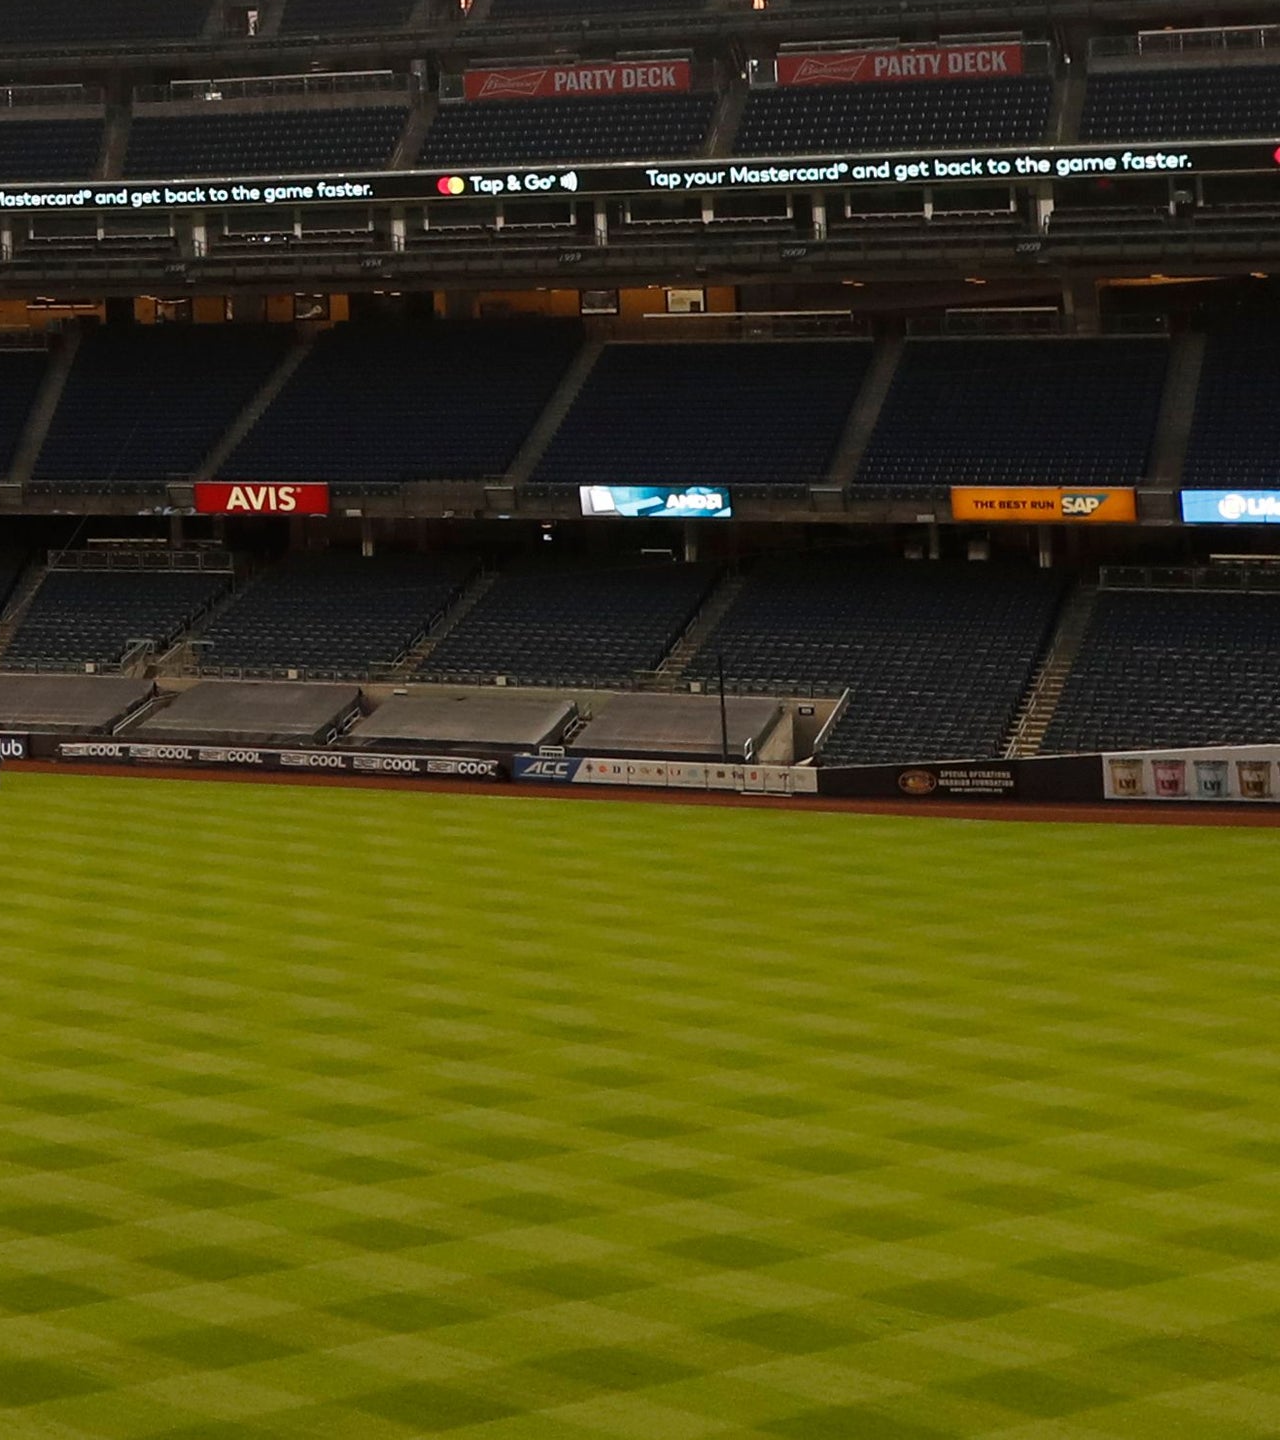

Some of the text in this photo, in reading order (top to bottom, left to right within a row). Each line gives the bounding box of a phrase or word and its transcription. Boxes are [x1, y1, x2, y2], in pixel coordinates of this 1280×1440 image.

[874, 50, 1007, 77] PARTY DECK
[554, 66, 676, 91] PARTY DECK
[646, 170, 680, 189] Tap
[684, 171, 725, 189] your
[852, 161, 890, 179] and
[894, 162, 930, 181] get
[934, 159, 983, 177] back
[987, 160, 1011, 176] to
[1015, 156, 1051, 174] the
[1056, 157, 1117, 176] game
[1122, 151, 1193, 171] faster.
[470, 176, 504, 195] Tap
[507, 175, 521, 192] &
[95, 188, 128, 205] and
[132, 190, 161, 208] get
[165, 187, 205, 203] back
[208, 188, 228, 202] to
[231, 185, 261, 201] the
[265, 186, 313, 203] game
[317, 181, 374, 199] faster.
[781, 247, 808, 258] 2000
[225, 486, 297, 511] AVIS
[973, 500, 1055, 510] THE BEST RUN
[1061, 497, 1100, 514] SAP
[88, 745, 123, 757] COOL
[157, 747, 193, 760] COOL
[227, 751, 263, 763] COOL
[309, 755, 346, 768] COOL
[383, 759, 421, 772] COOL
[523, 760, 570, 776] ACC
